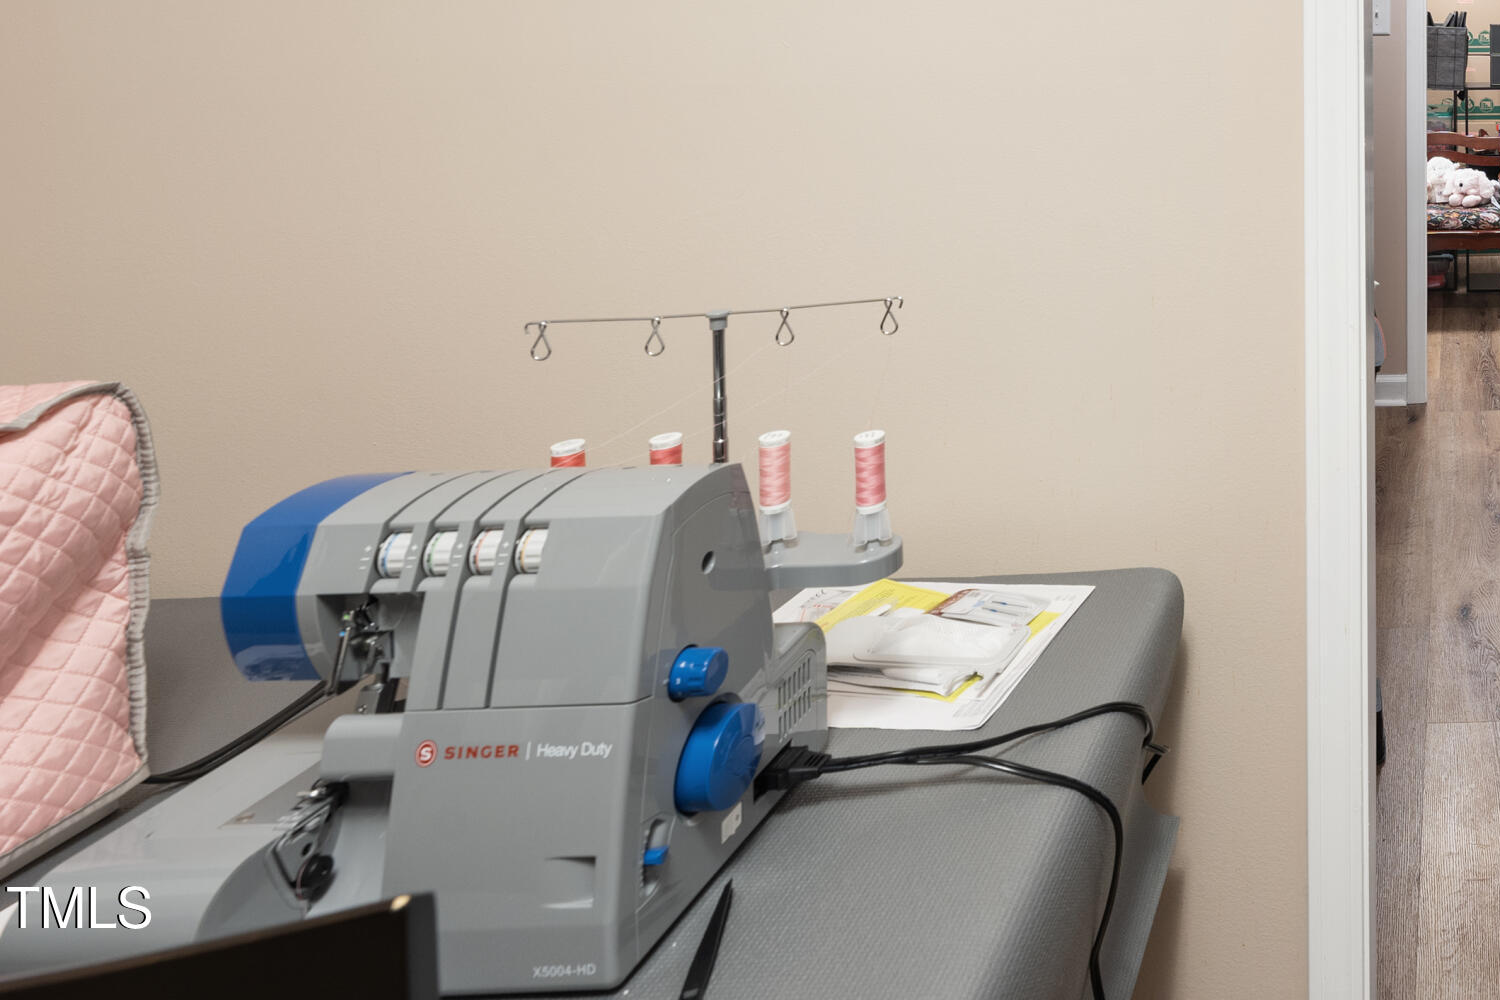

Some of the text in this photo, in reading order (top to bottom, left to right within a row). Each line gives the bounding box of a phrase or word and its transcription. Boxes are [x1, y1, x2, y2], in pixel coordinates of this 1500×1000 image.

[444, 744, 520, 760] SINGER
[537, 742, 579, 760] Heavy
[581, 741, 613, 759] Duty
[532, 963, 597, 978] X5004-HD
